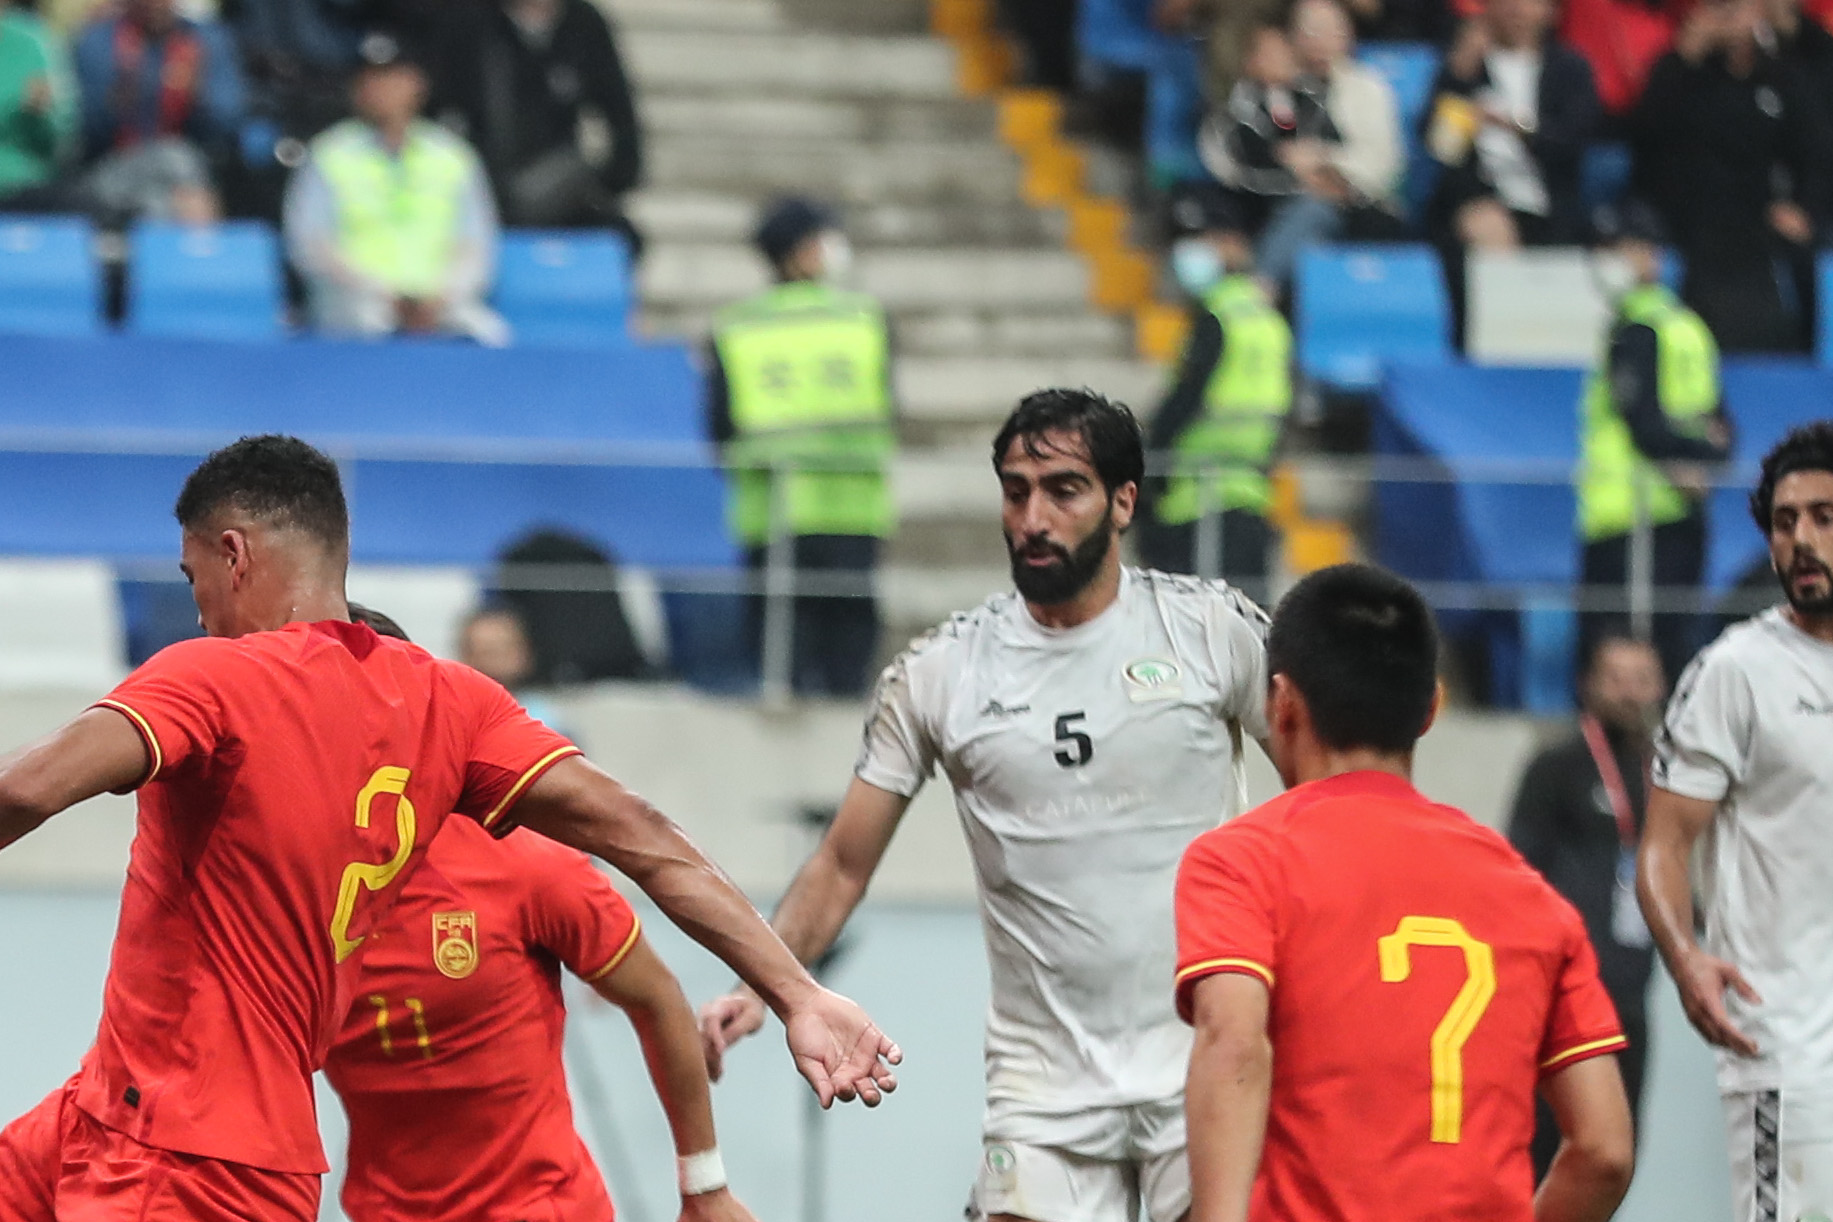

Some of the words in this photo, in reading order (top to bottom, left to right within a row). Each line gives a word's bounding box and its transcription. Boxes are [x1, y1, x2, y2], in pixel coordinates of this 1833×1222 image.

[1054, 711, 1093, 768] 5
[330, 765, 416, 964] 2
[368, 994, 434, 1059] 11
[1378, 915, 1497, 1144] 7
